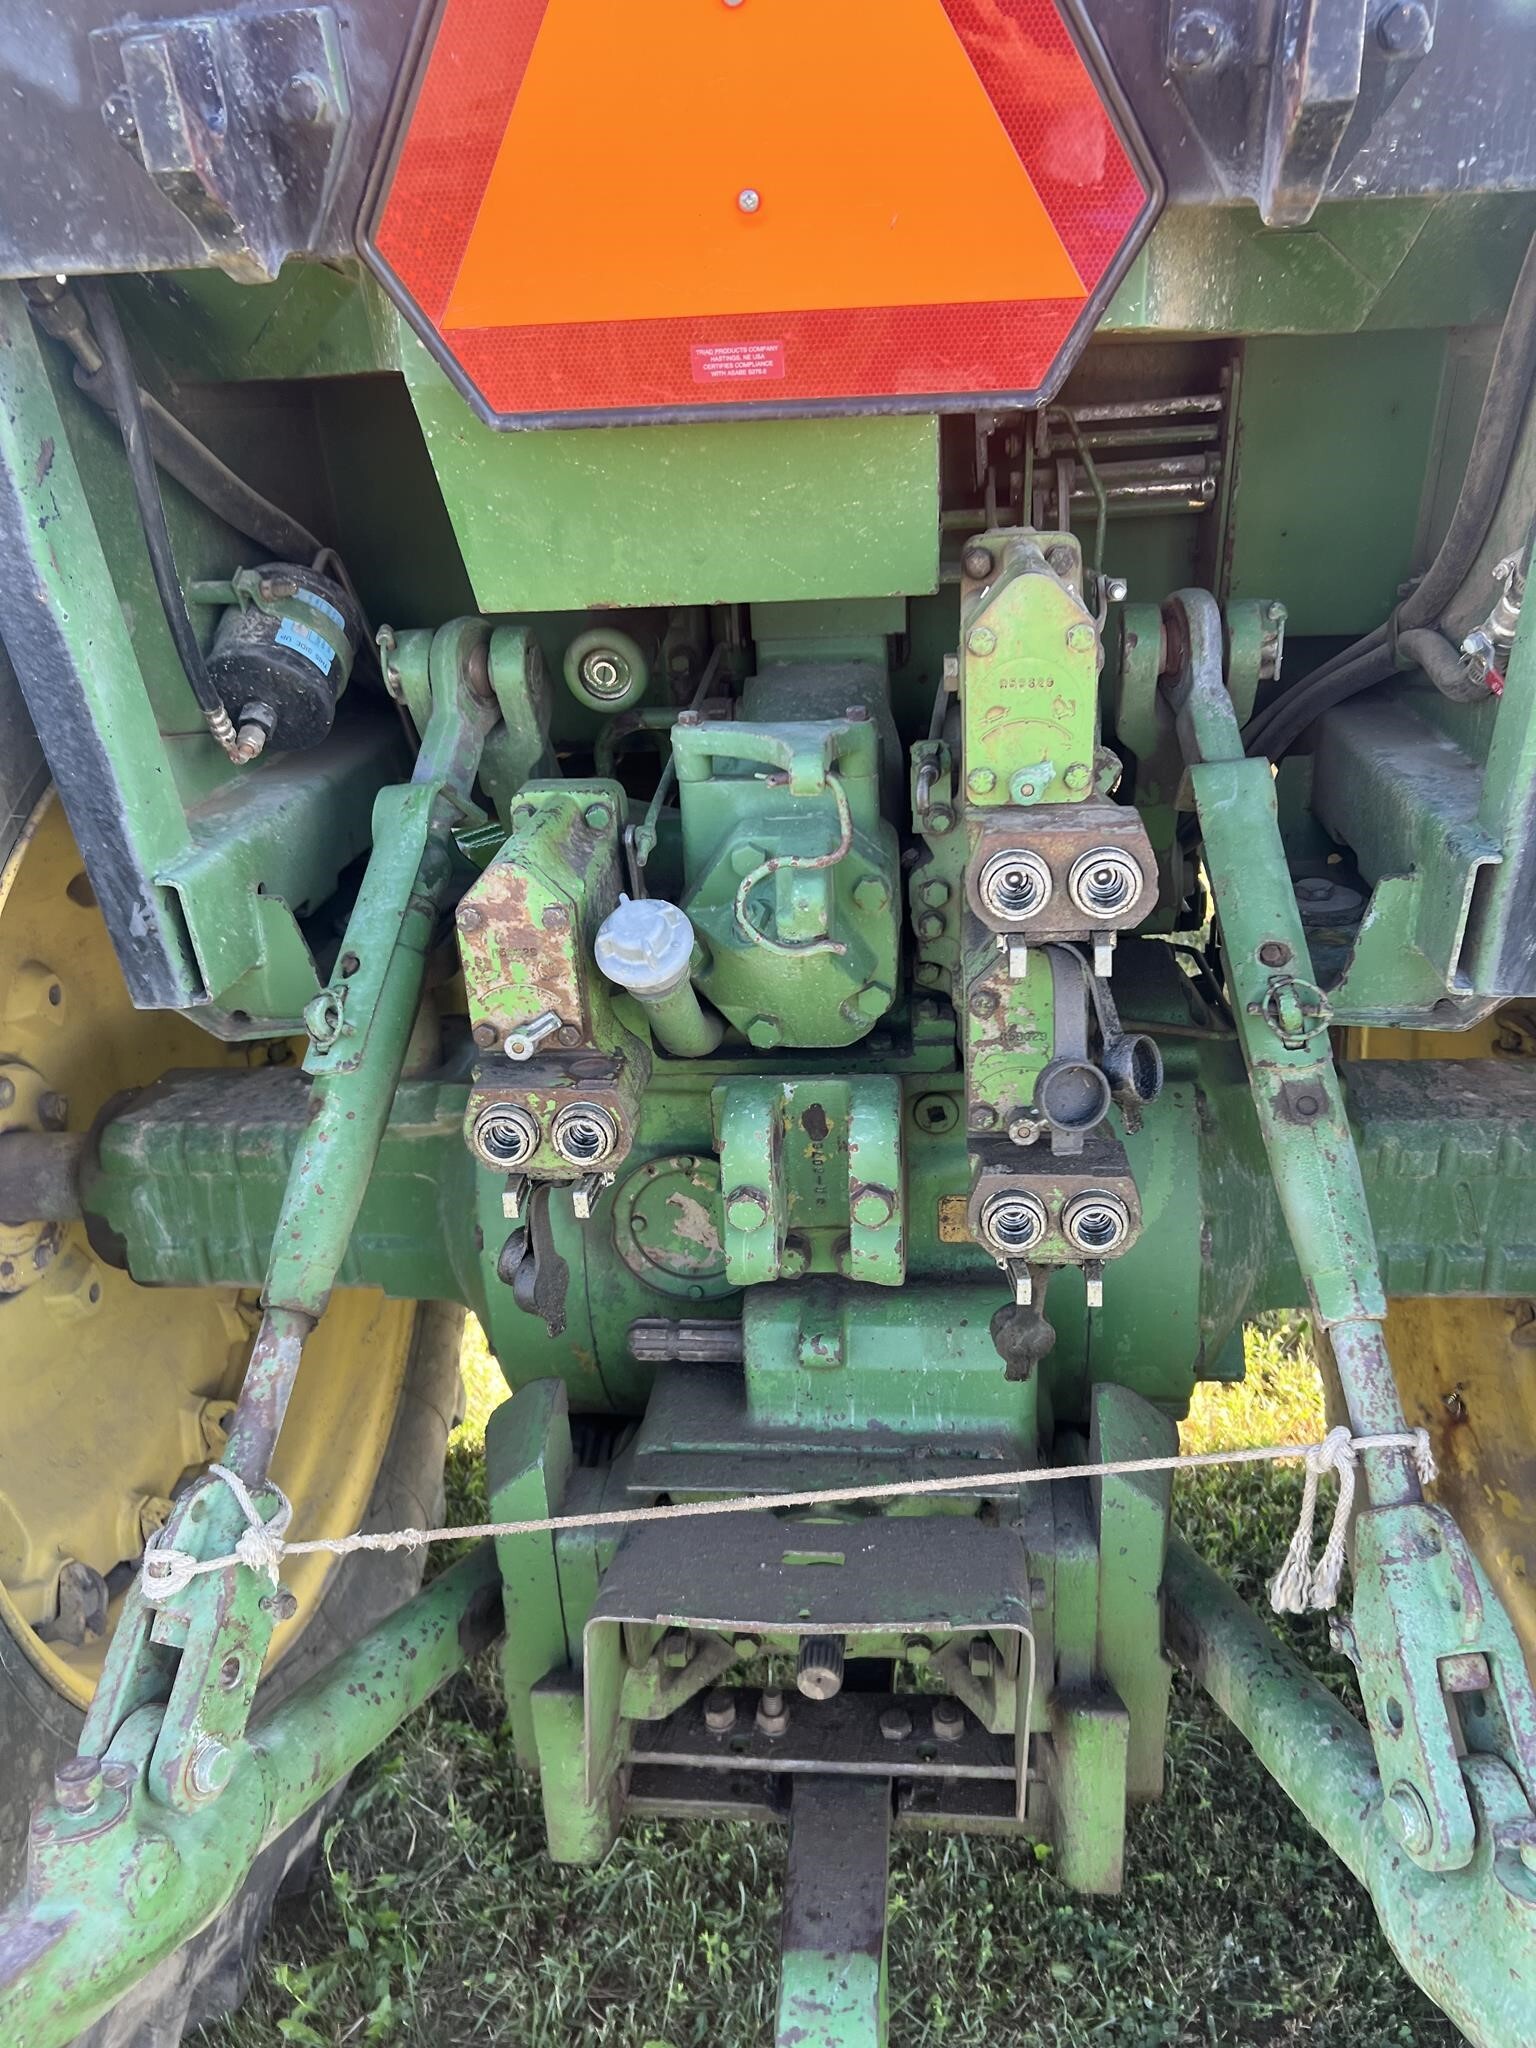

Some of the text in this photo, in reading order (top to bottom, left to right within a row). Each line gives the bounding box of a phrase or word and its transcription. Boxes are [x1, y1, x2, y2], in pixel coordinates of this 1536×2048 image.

[714, 347, 747, 355] PRODUCTS
[748, 345, 778, 353] COMPANY
[734, 360, 774, 368] COMPLIANCE
